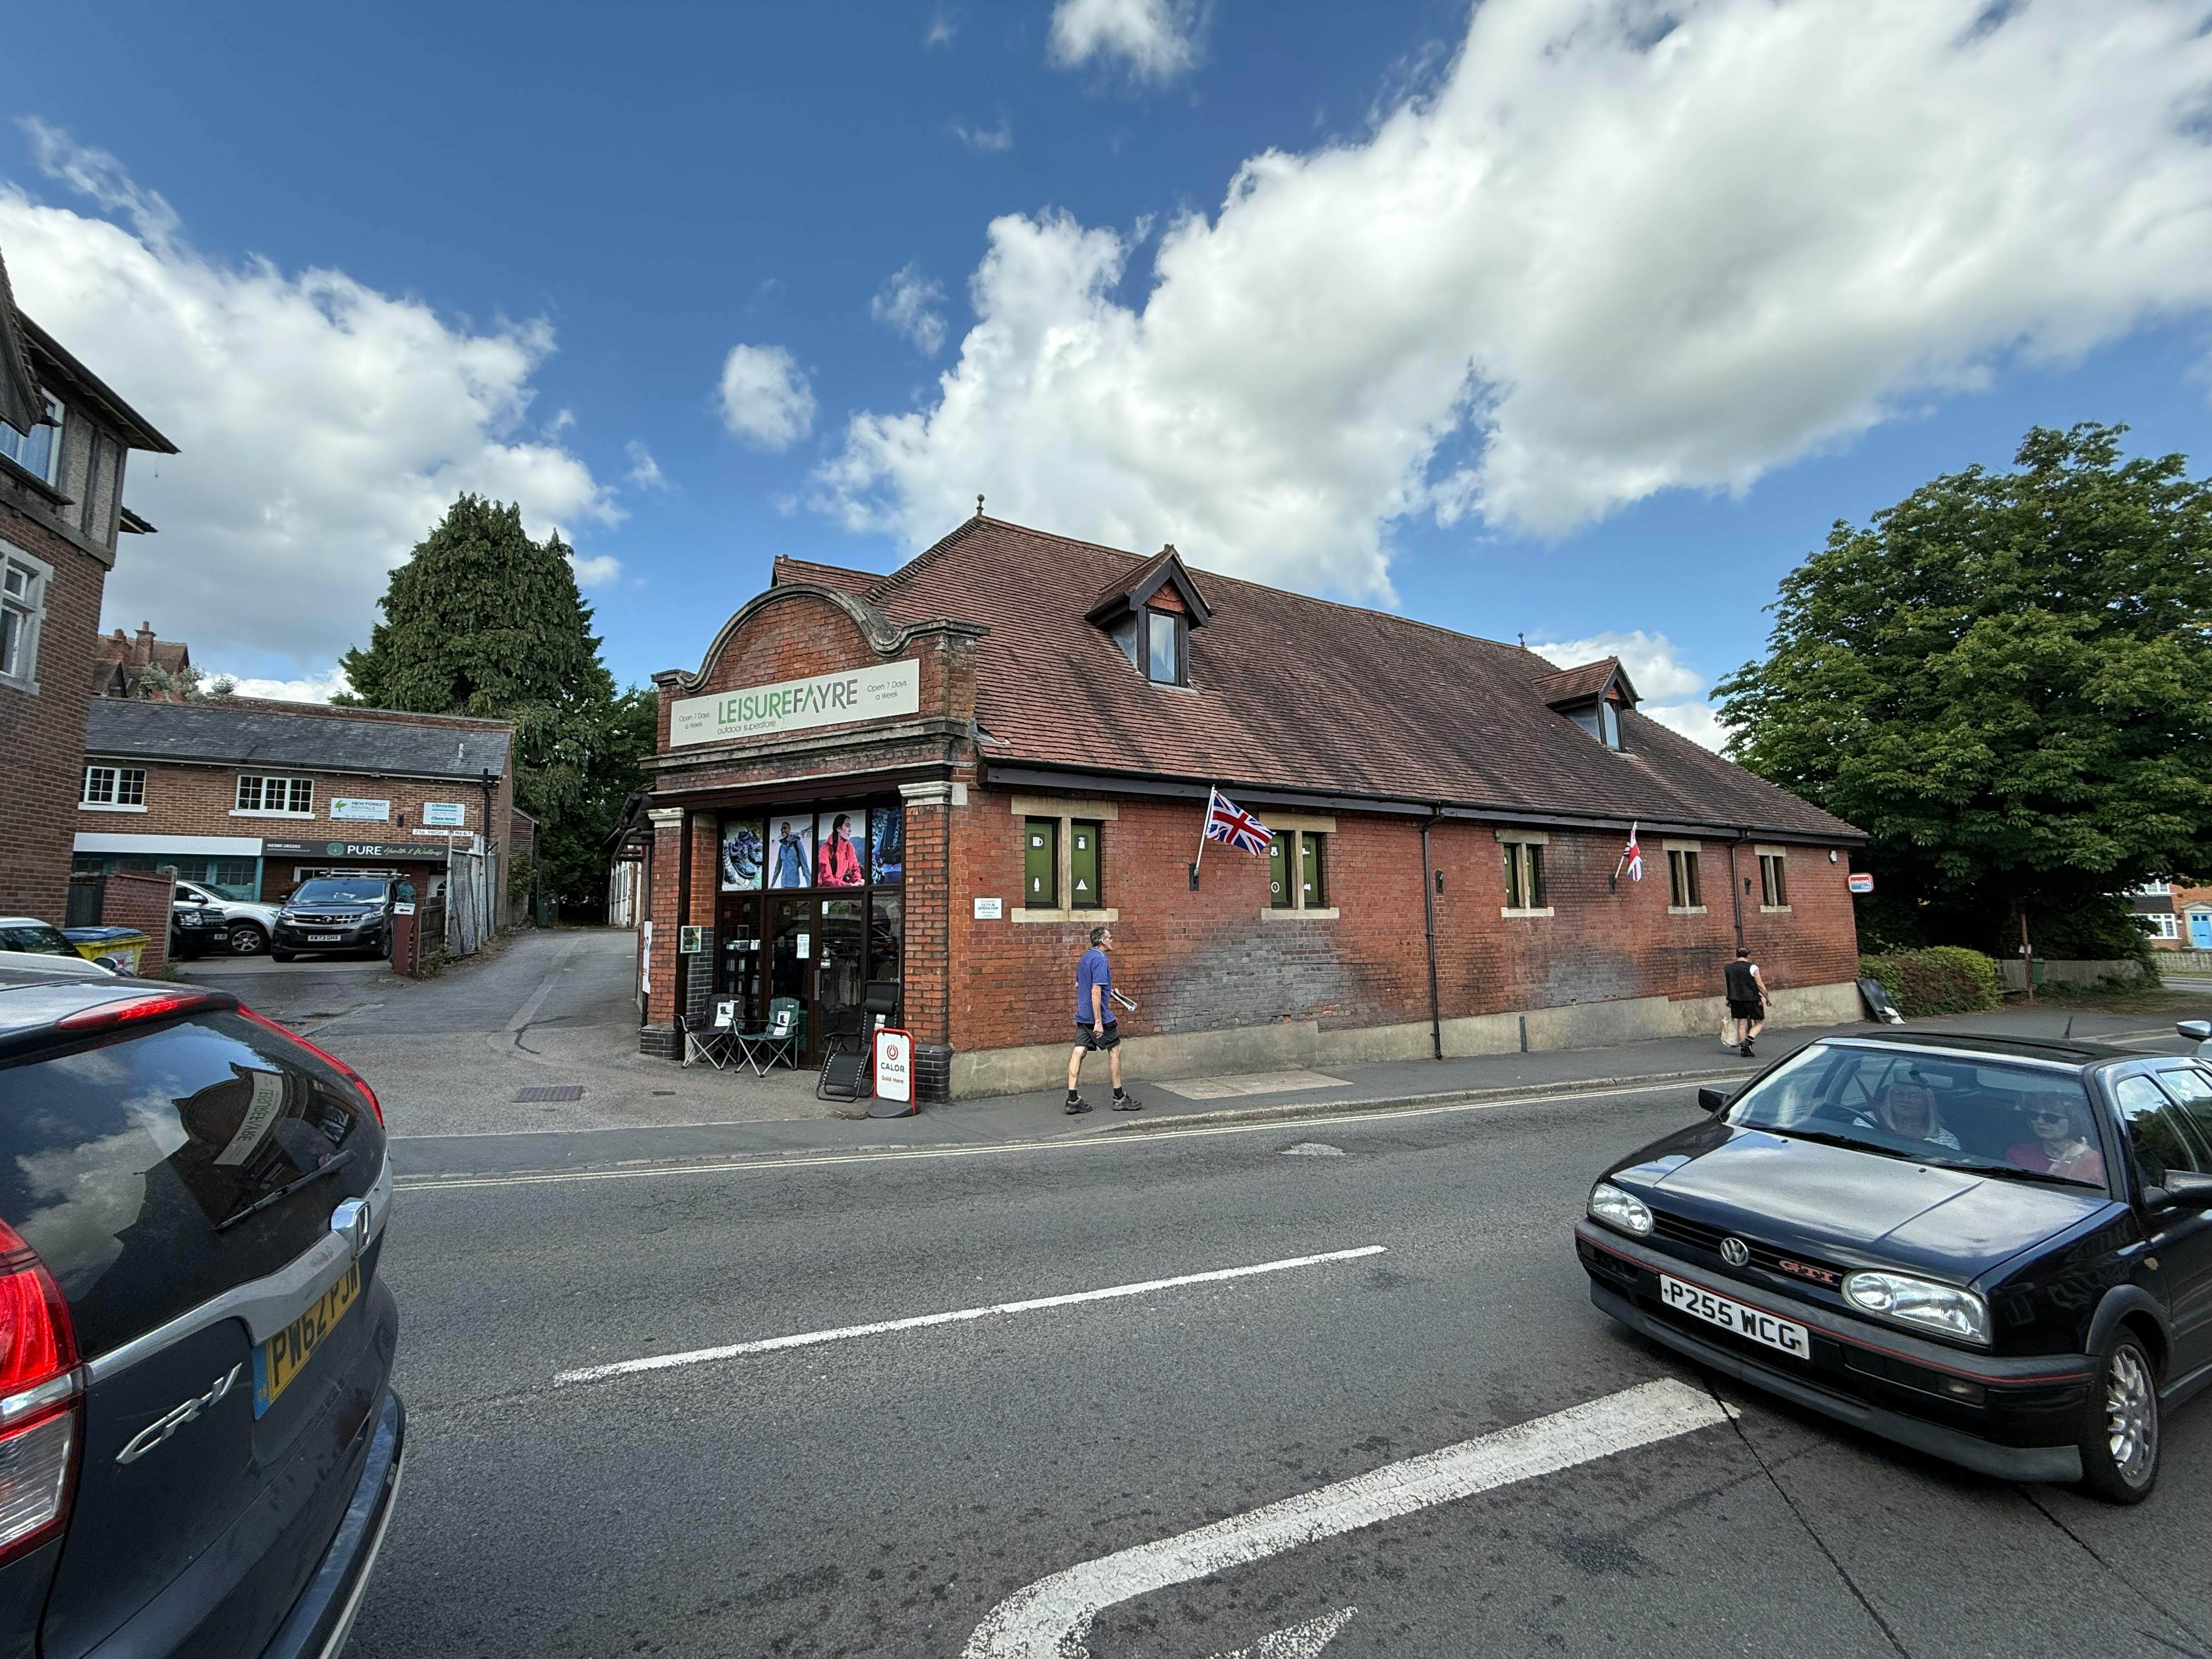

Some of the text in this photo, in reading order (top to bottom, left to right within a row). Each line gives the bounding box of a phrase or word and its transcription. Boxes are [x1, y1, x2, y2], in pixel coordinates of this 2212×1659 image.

[867, 684, 885, 692] Open
[891, 680, 907, 689] Days
[718, 679, 857, 724] LEISUREFAYRE
[718, 720, 776, 735] outdoor superstore
[347, 845, 382, 855] PURE
[384, 847, 407, 855] Health
[413, 847, 443, 856] Wellness
[881, 1062, 905, 1073] CALOR
[1779, 1260, 1833, 1283] GTI
[1669, 1282, 1798, 1350] P255 WCG
